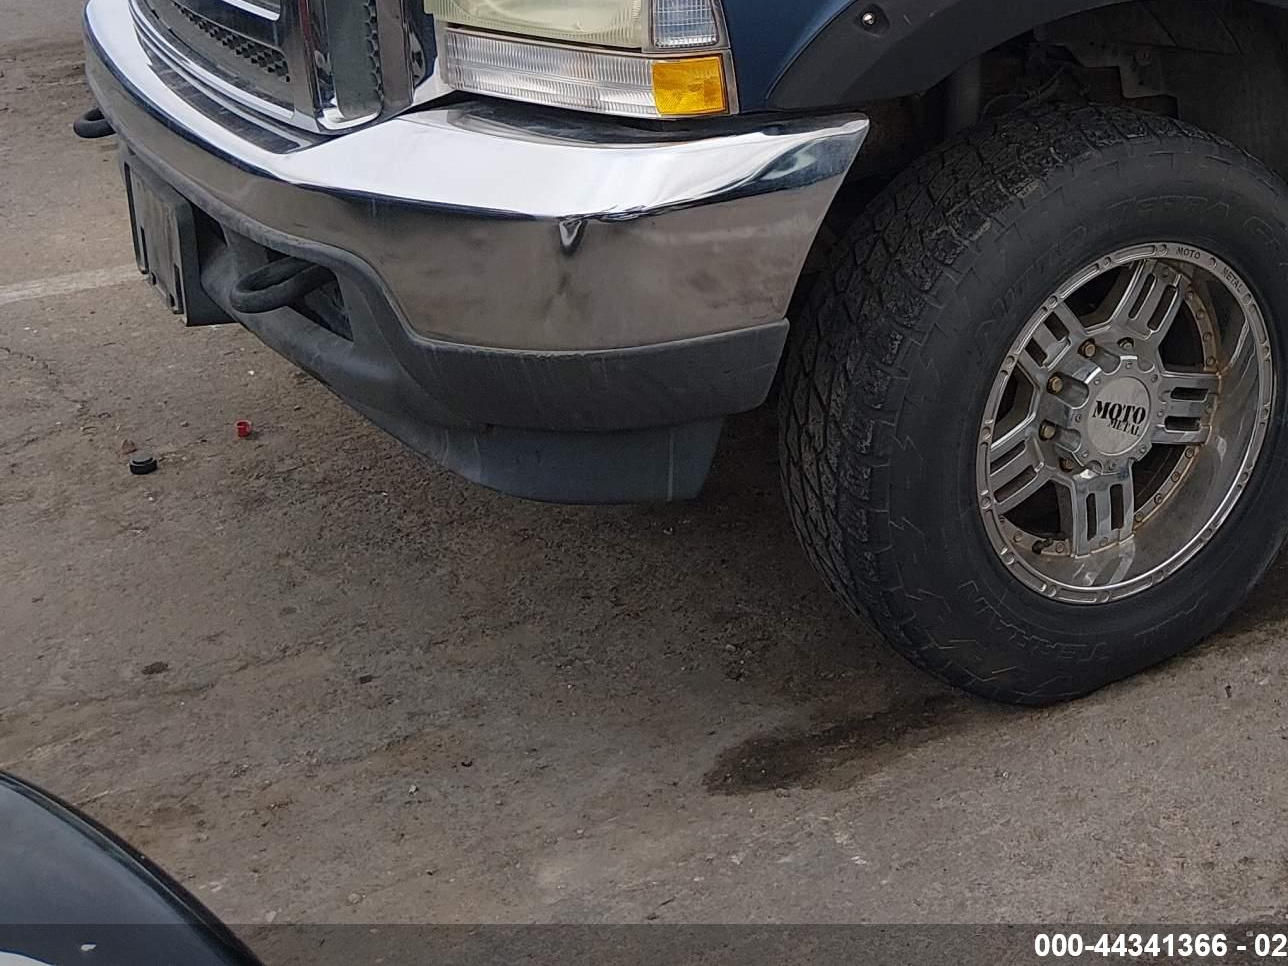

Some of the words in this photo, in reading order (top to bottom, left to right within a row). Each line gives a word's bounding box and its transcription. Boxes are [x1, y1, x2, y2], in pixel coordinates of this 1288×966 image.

[1176, 246, 1201, 260] MOTO
[1222, 266, 1243, 293] METAL
[1092, 400, 1147, 425] MOTO
[1108, 420, 1140, 437] METAL
